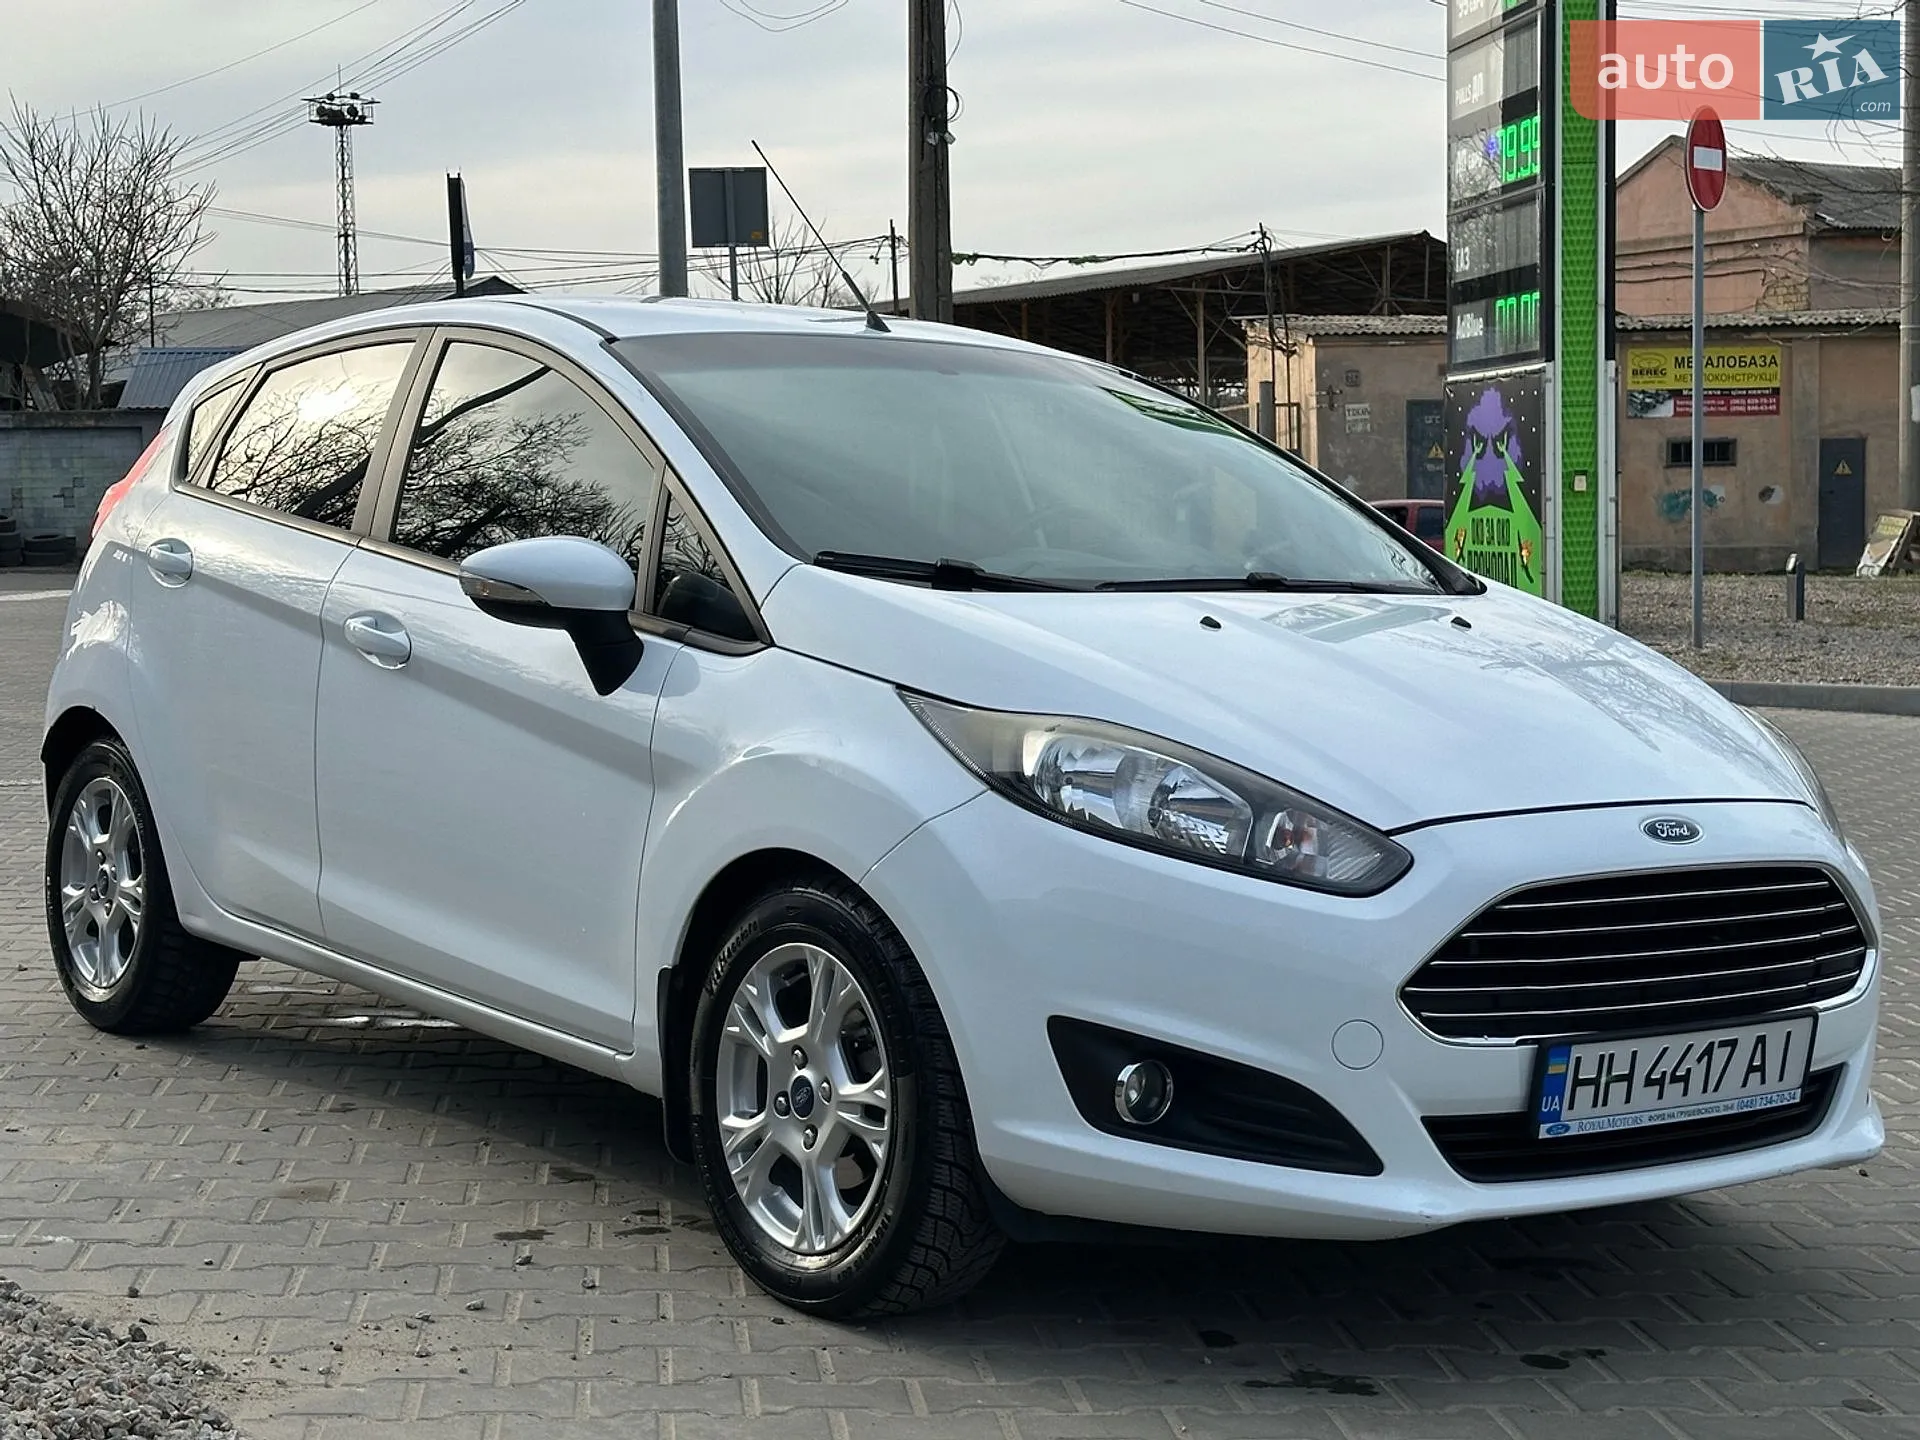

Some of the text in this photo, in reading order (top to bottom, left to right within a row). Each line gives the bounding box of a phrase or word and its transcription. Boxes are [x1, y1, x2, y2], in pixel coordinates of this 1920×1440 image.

[1456, 246, 1470, 273] ГАЗ
[1674, 354, 1778, 369] МЕАЛОБАЗА
[1655, 821, 1690, 837] Ford
[1567, 1048, 1638, 1111] HH
[1643, 1037, 1738, 1101] 4417
[1541, 1095, 1560, 1112] UA
